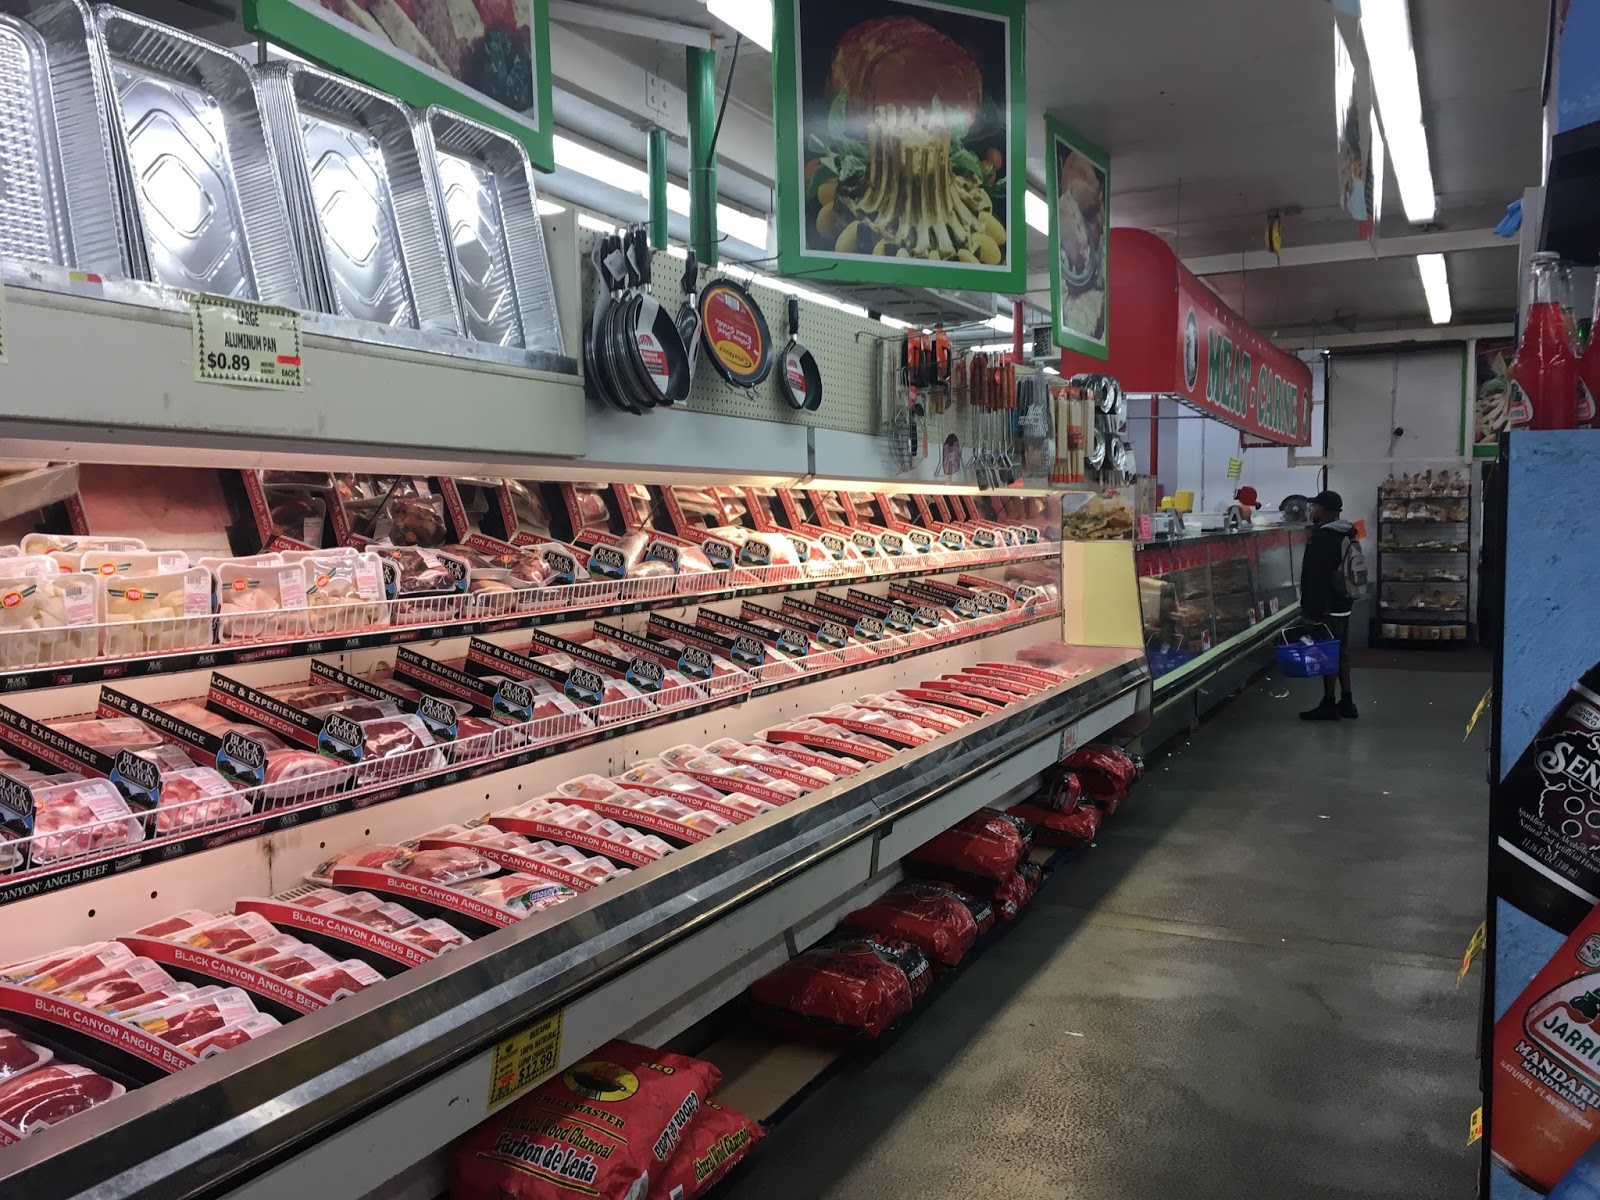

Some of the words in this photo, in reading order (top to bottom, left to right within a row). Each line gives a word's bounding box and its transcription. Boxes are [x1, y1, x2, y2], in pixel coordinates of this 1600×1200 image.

[237, 309, 259, 327] LARGE
[225, 332, 262, 351] ALUMINUM
[263, 336, 276, 352] PAN
[208, 351, 250, 371] $0.89
[281, 369, 296, 378] EACH
[1206, 325, 1251, 419] MEAT
[1257, 364, 1298, 439] CARNE
[599, 548, 621, 560] BLACK
[678, 624, 724, 645] EXPERIENCE
[724, 617, 770, 638] EXPERIENCE
[535, 632, 556, 647] LORE
[566, 642, 618, 668] EXPERIENCE
[594, 624, 614, 636] LORE
[623, 632, 670, 656] EXPERIENCE
[736, 642, 762, 656] CANYON
[740, 636, 761, 649] BLACK
[471, 640, 492, 654] LORE
[503, 652, 556, 678] EXPERIENCE
[636, 658, 658, 673] BLACK
[682, 654, 710, 668] CANYON
[686, 648, 708, 662] BLACK
[398, 650, 419, 664] LORE
[422, 658, 428, 668] &
[431, 662, 485, 691] EXPERIENCE
[576, 669, 600, 685] BLACK
[632, 666, 660, 681] CANYON
[312, 662, 334, 678] LORE
[338, 672, 344, 682] &
[347, 678, 404, 708] EXPERIENCE
[504, 681, 530, 698] BLACK
[572, 676, 600, 692] CANYON
[212, 676, 235, 692] LORE
[238, 688, 245, 698] &
[249, 691, 309, 726] EXPERIENCE
[426, 698, 452, 716] BLACK
[500, 688, 530, 706] CANYON
[101, 692, 128, 710] LORE
[130, 703, 138, 714] &
[142, 706, 206, 746] EXPERIENCE
[332, 714, 360, 736] BLACK
[422, 705, 454, 726] CANYON
[1574, 710, 1597, 727] MEXICO
[0, 708, 16, 725] ORE
[19, 717, 28, 730] &
[30, 724, 98, 764] EXPERIENCE
[230, 735, 260, 757] BLACK
[326, 724, 360, 746] CANYON
[804, 734, 824, 743] BLACK
[826, 738, 852, 749] CANYON
[853, 745, 876, 756] ANGUS
[122, 752, 154, 776] BLACK
[226, 744, 262, 766] CANYON
[118, 761, 156, 788] CANYON
[0, 779, 27, 800] BLACK
[712, 776, 743, 790] CANYON
[744, 785, 770, 797] ANGUS
[0, 791, 29, 814] ANYON
[671, 792, 703, 806] CANYON
[704, 802, 731, 816] ANGUS
[594, 804, 620, 816] BLACK
[622, 808, 656, 824] CANYON
[657, 818, 684, 834] ANGUS
[1518, 807, 1545, 831] Sparkling
[536, 824, 564, 837] BLACK
[566, 830, 600, 846] CANYON
[601, 841, 630, 856] ANGUS
[1519, 819, 1542, 837] Natural
[1541, 834, 1556, 846] and
[1554, 842, 1582, 862] Artificial
[1522, 838, 1538, 853] 11.16
[44, 871, 81, 890] ANGUS
[82, 864, 108, 880] BEEF
[501, 854, 538, 871] CANYON
[540, 865, 570, 882] ANGUS
[388, 878, 418, 893] BLACK
[420, 886, 459, 904] CANYON
[461, 899, 494, 918] ANGUS
[292, 910, 324, 927] BLACK
[326, 920, 368, 940] CANYON
[370, 934, 404, 955] ANGUS
[174, 950, 208, 967] BLACK
[211, 959, 255, 984] CANYON
[257, 976, 294, 1000] ANGUS
[35, 998, 71, 1018] BLACK
[73, 1010, 119, 1038] CANYON
[122, 1032, 160, 1056] ANGUS
[1500, 1060, 1534, 1090] NATURAL
[1535, 1086, 1570, 1114] FLAVOR
[1522, 1060, 1586, 1112] MANDARINA
[568, 1124, 616, 1160] Charcoal
[494, 1132, 545, 1167] Carbon
[542, 1143, 563, 1171] de
[560, 1149, 598, 1184] Leña
